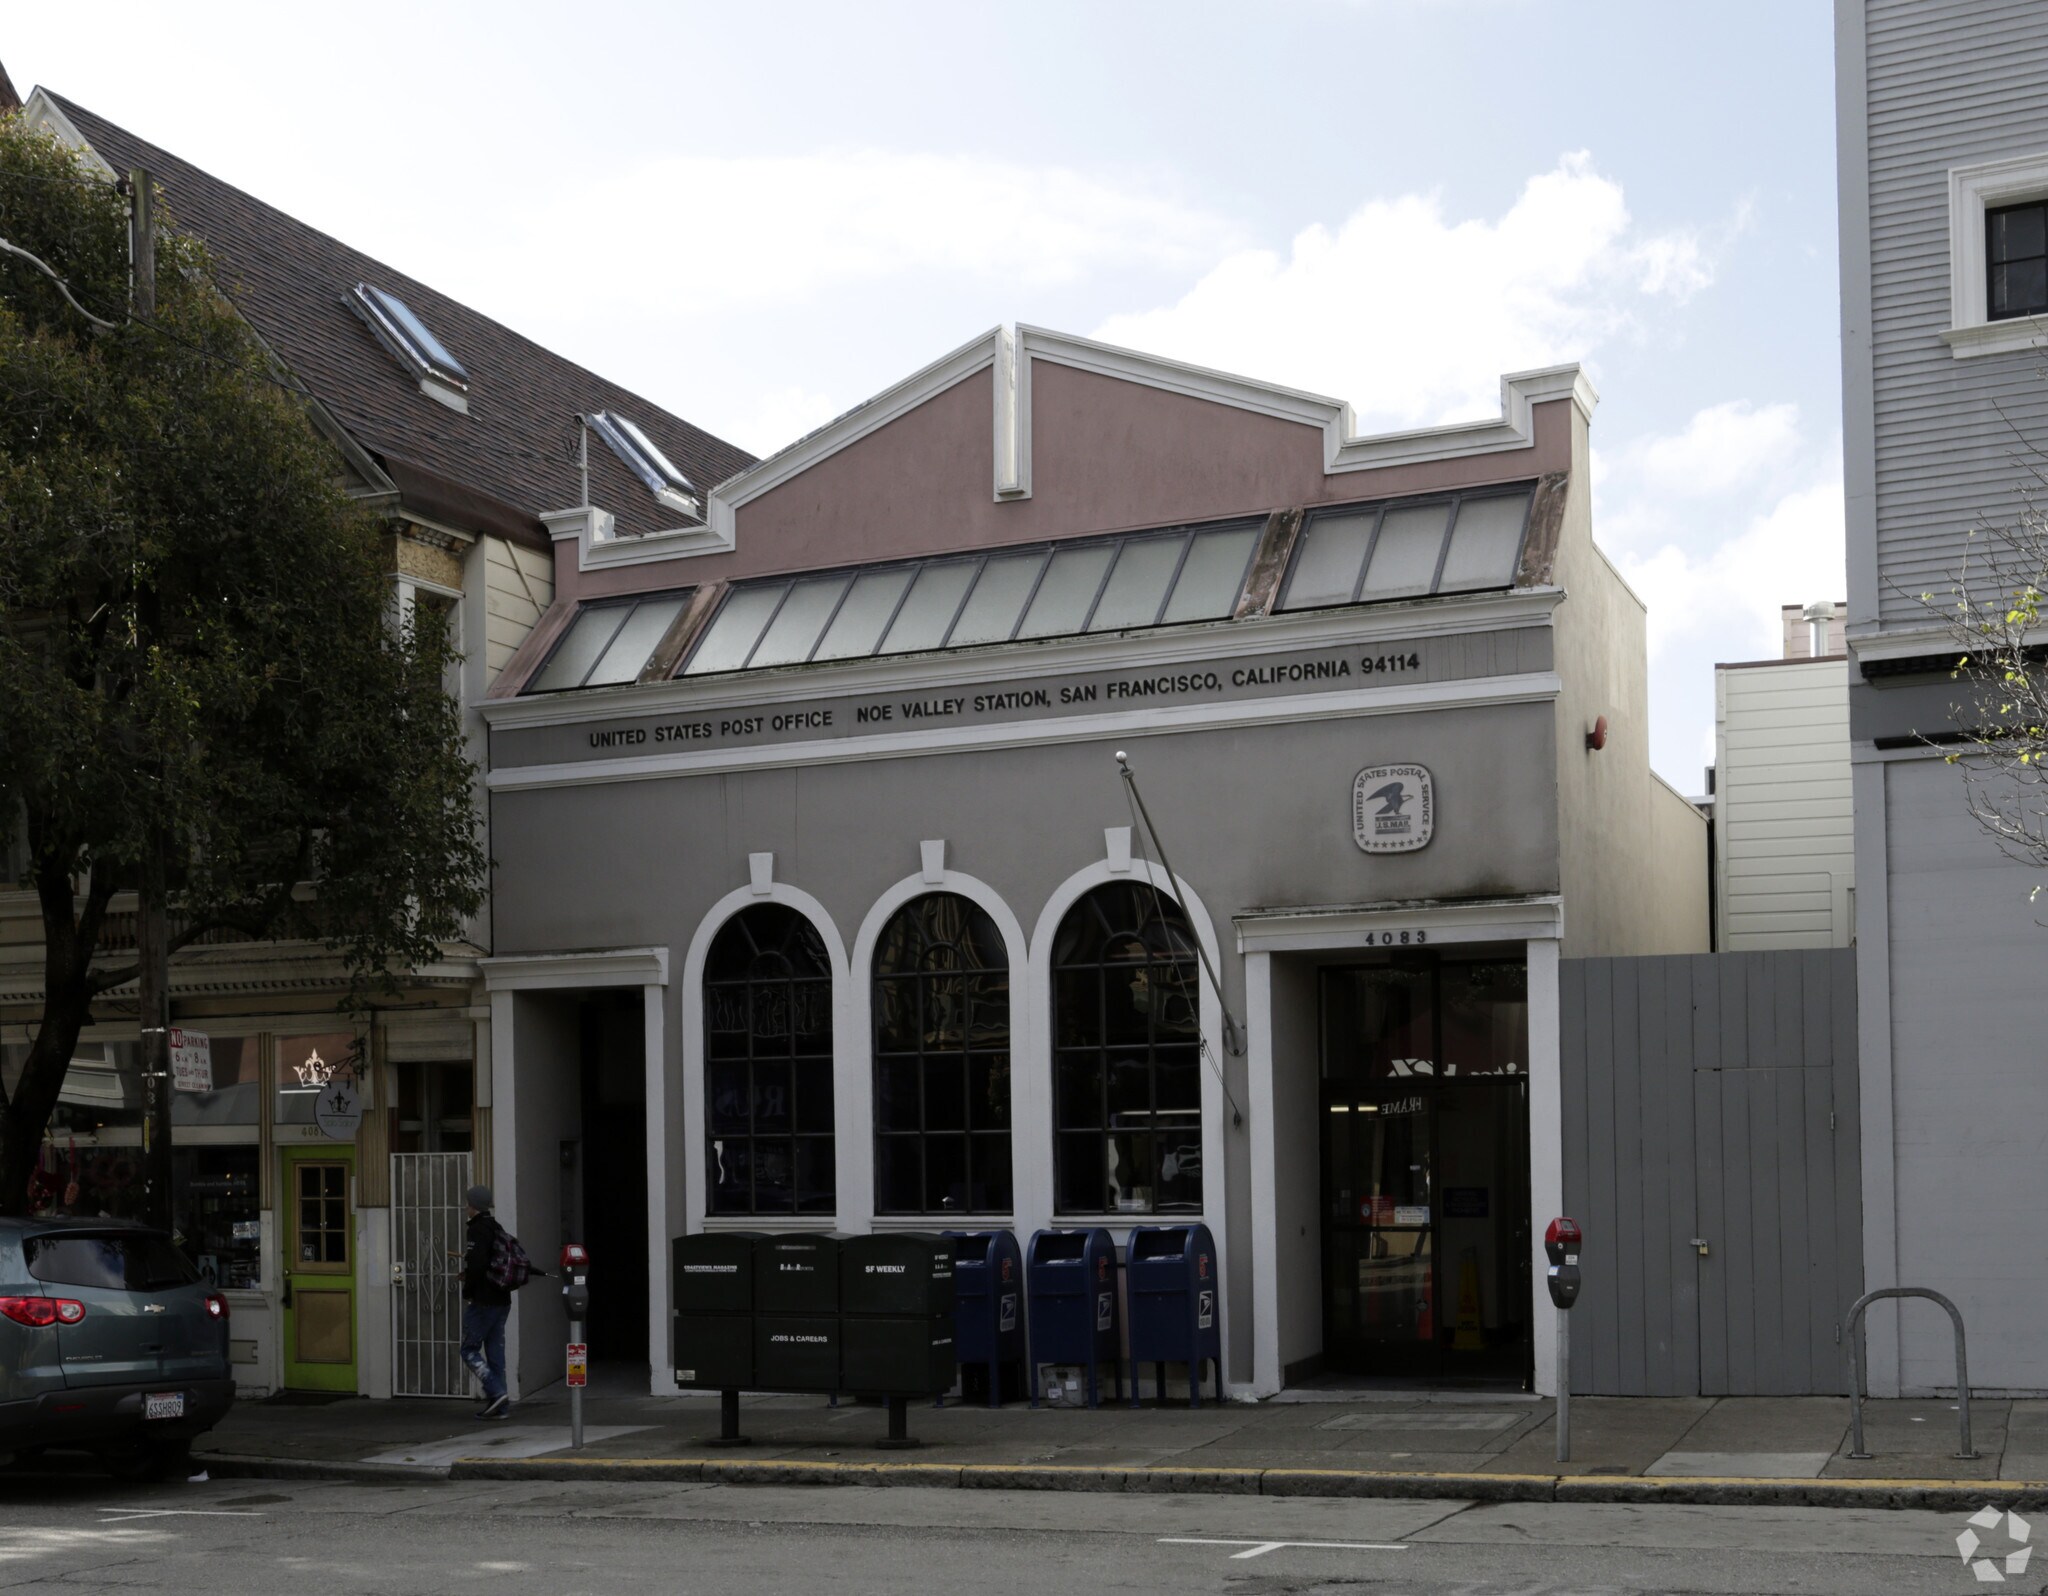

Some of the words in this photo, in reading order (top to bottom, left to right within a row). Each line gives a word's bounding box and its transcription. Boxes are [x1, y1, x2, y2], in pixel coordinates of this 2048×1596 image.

[589, 728, 647, 748] UNITED
[655, 722, 712, 742] STATES
[721, 717, 764, 736] POST
[771, 710, 833, 732] OFFICE
[857, 704, 893, 723] NOE
[901, 697, 965, 719] VALLEY
[974, 689, 1052, 713] STATION,
[1060, 684, 1097, 703] SAN
[1107, 673, 1223, 699] FRANCISCO,
[1232, 660, 1351, 687] CALIFORNIA
[1361, 653, 1420, 674] 94114
[1357, 769, 1388, 789] STATES
[1390, 767, 1426, 783] POSTAL
[1356, 791, 1365, 830] UNITED
[1421, 784, 1430, 825] SERVICE
[1365, 930, 1426, 946] 4083
[171, 1030, 182, 1047] NO
[183, 1035, 208, 1049] PARKING
[175, 1051, 180, 1062] 6
[194, 1052, 199, 1063] 8
[865, 1265, 875, 1273] SF
[876, 1265, 905, 1273] WEEKLY
[796, 1335, 827, 1343] CAREERS
